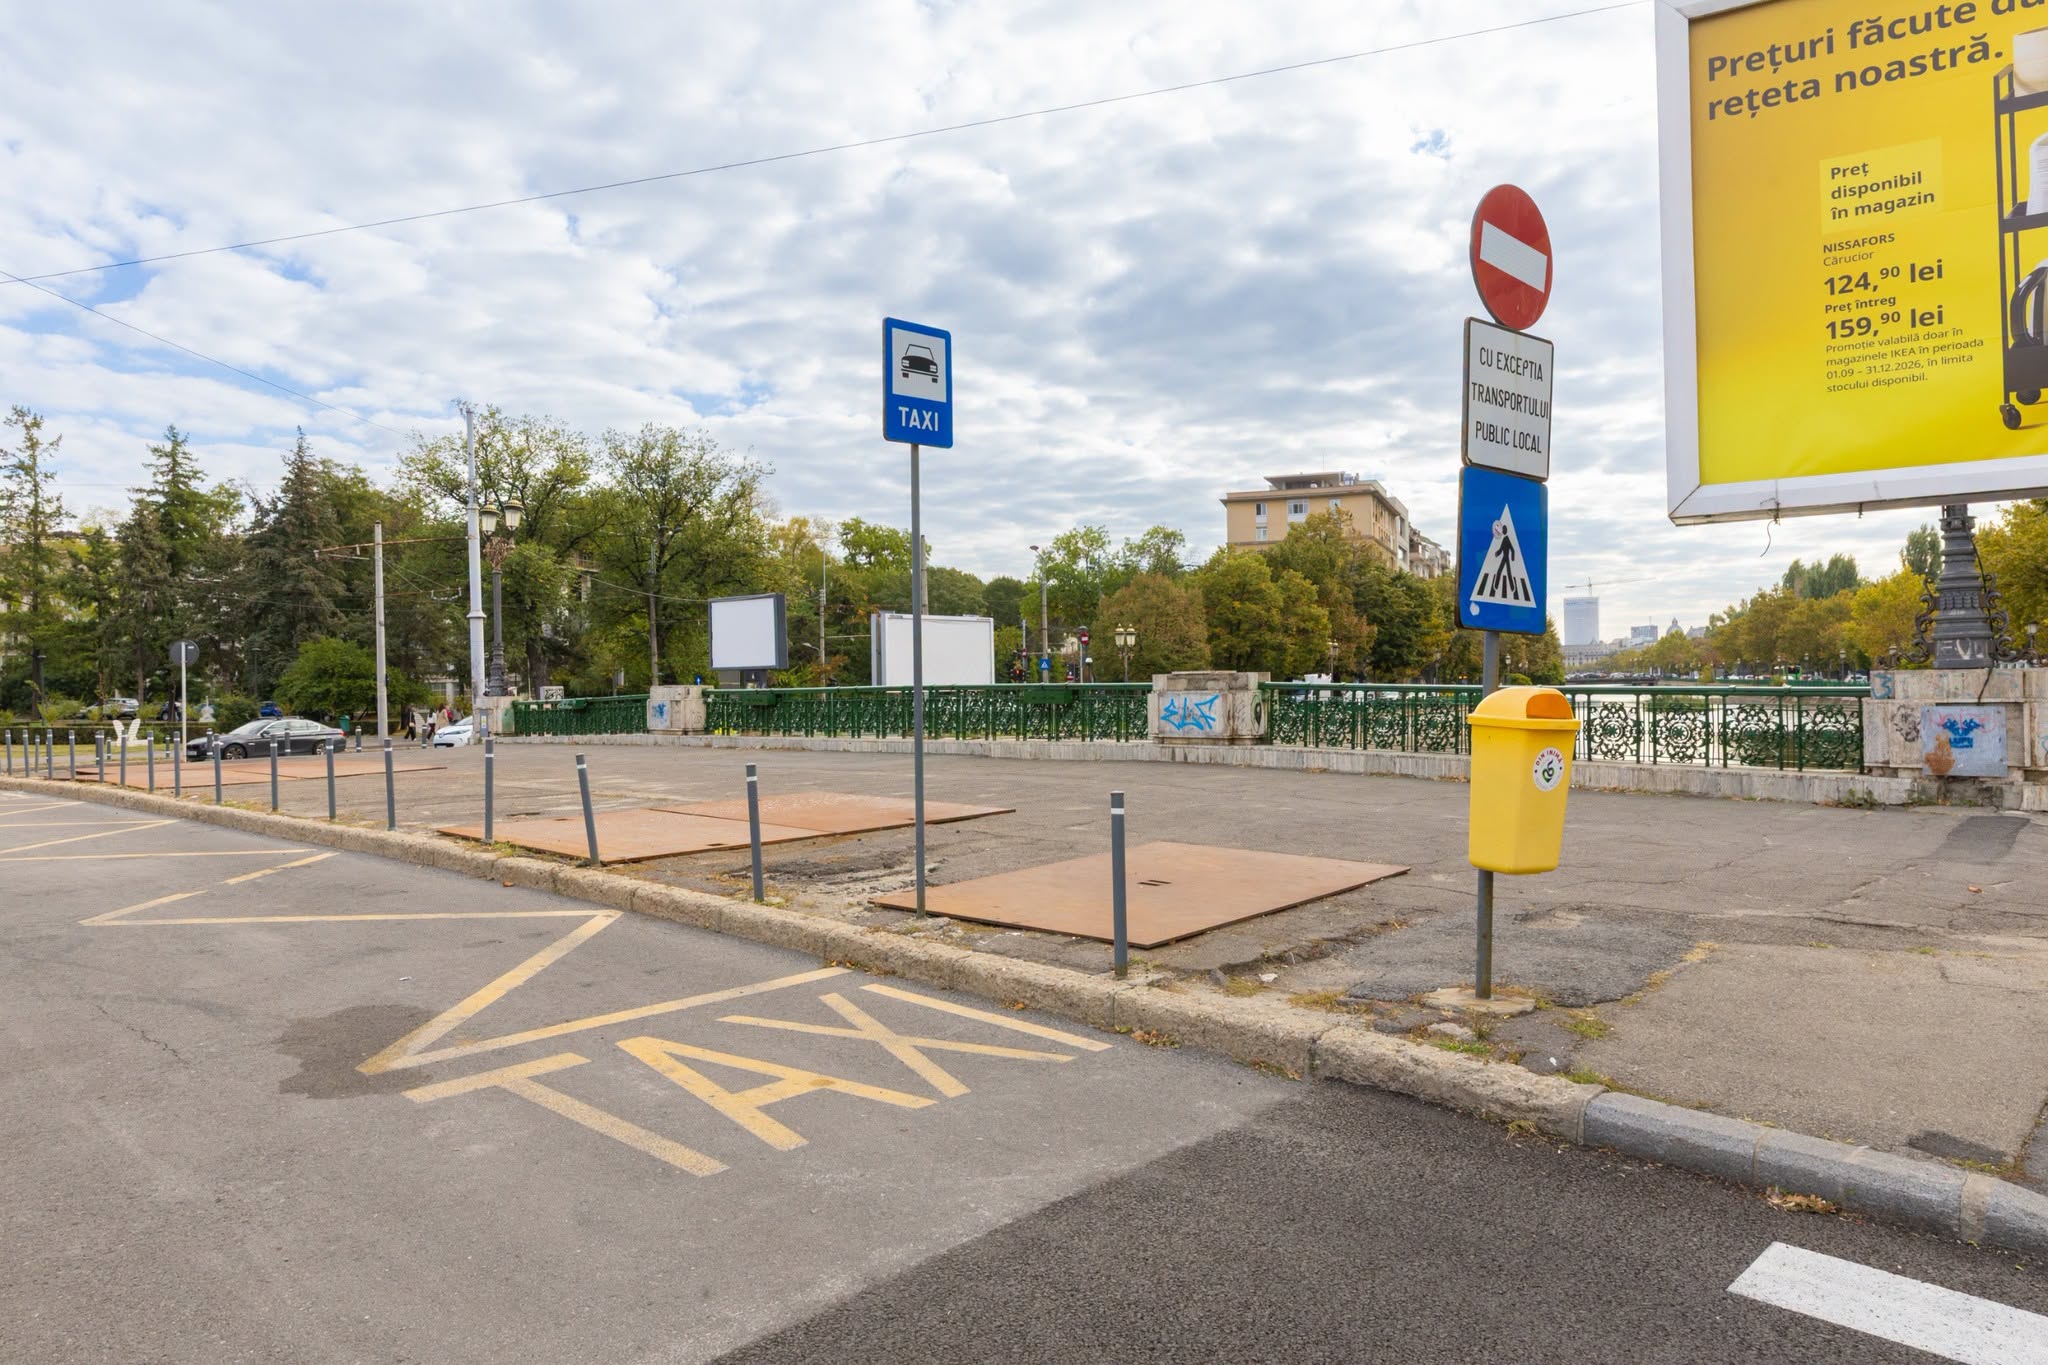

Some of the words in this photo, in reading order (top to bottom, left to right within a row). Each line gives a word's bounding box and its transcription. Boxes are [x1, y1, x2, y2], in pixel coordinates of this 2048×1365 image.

[1708, 28, 1834, 81] Prețuri
[1847, 1, 1976, 49] făcute
[1708, 79, 1821, 120] rețeta
[1834, 33, 2003, 92] noastră.
[1831, 162, 1869, 180] Preț
[1831, 171, 1922, 200] disponibil
[1831, 207, 1848, 220] în
[1855, 191, 1935, 216] magazin
[1823, 233, 1895, 253] NISSAFORS
[1823, 251, 1875, 267] Cărucior
[1910, 259, 1943, 283] lei
[1824, 302, 1852, 314] Preț
[1855, 296, 1896, 311] întreg
[1910, 305, 1943, 329] lei
[1826, 340, 1876, 354] Promoție
[1878, 333, 1920, 347] valabilă
[1923, 330, 1949, 341] doar
[1952, 327, 1963, 337] în
[1826, 350, 1888, 367] magazinele
[1891, 347, 1917, 358] IKEA
[1919, 345, 1930, 354] în
[1933, 338, 1984, 355] perioada
[1480, 347, 1493, 367] CU
[1497, 352, 1543, 382] EXCEPȚIA
[1826, 367, 1854, 380] 01.09
[1867, 359, 1924, 376] 31.12.2026,
[1928, 357, 1938, 367] în
[1942, 353, 1973, 365] limita
[1826, 379, 1869, 393] stocului
[1872, 372, 1929, 388] disponibil.
[1472, 382, 1549, 419] TRANSPORTULUI
[898, 406, 939, 432] TAXI
[1476, 421, 1510, 446] PUBLIC
[1513, 429, 1542, 454] LOCAL
[1536, 753, 1545, 766] DIN
[401, 983, 1114, 1177] TAXI
